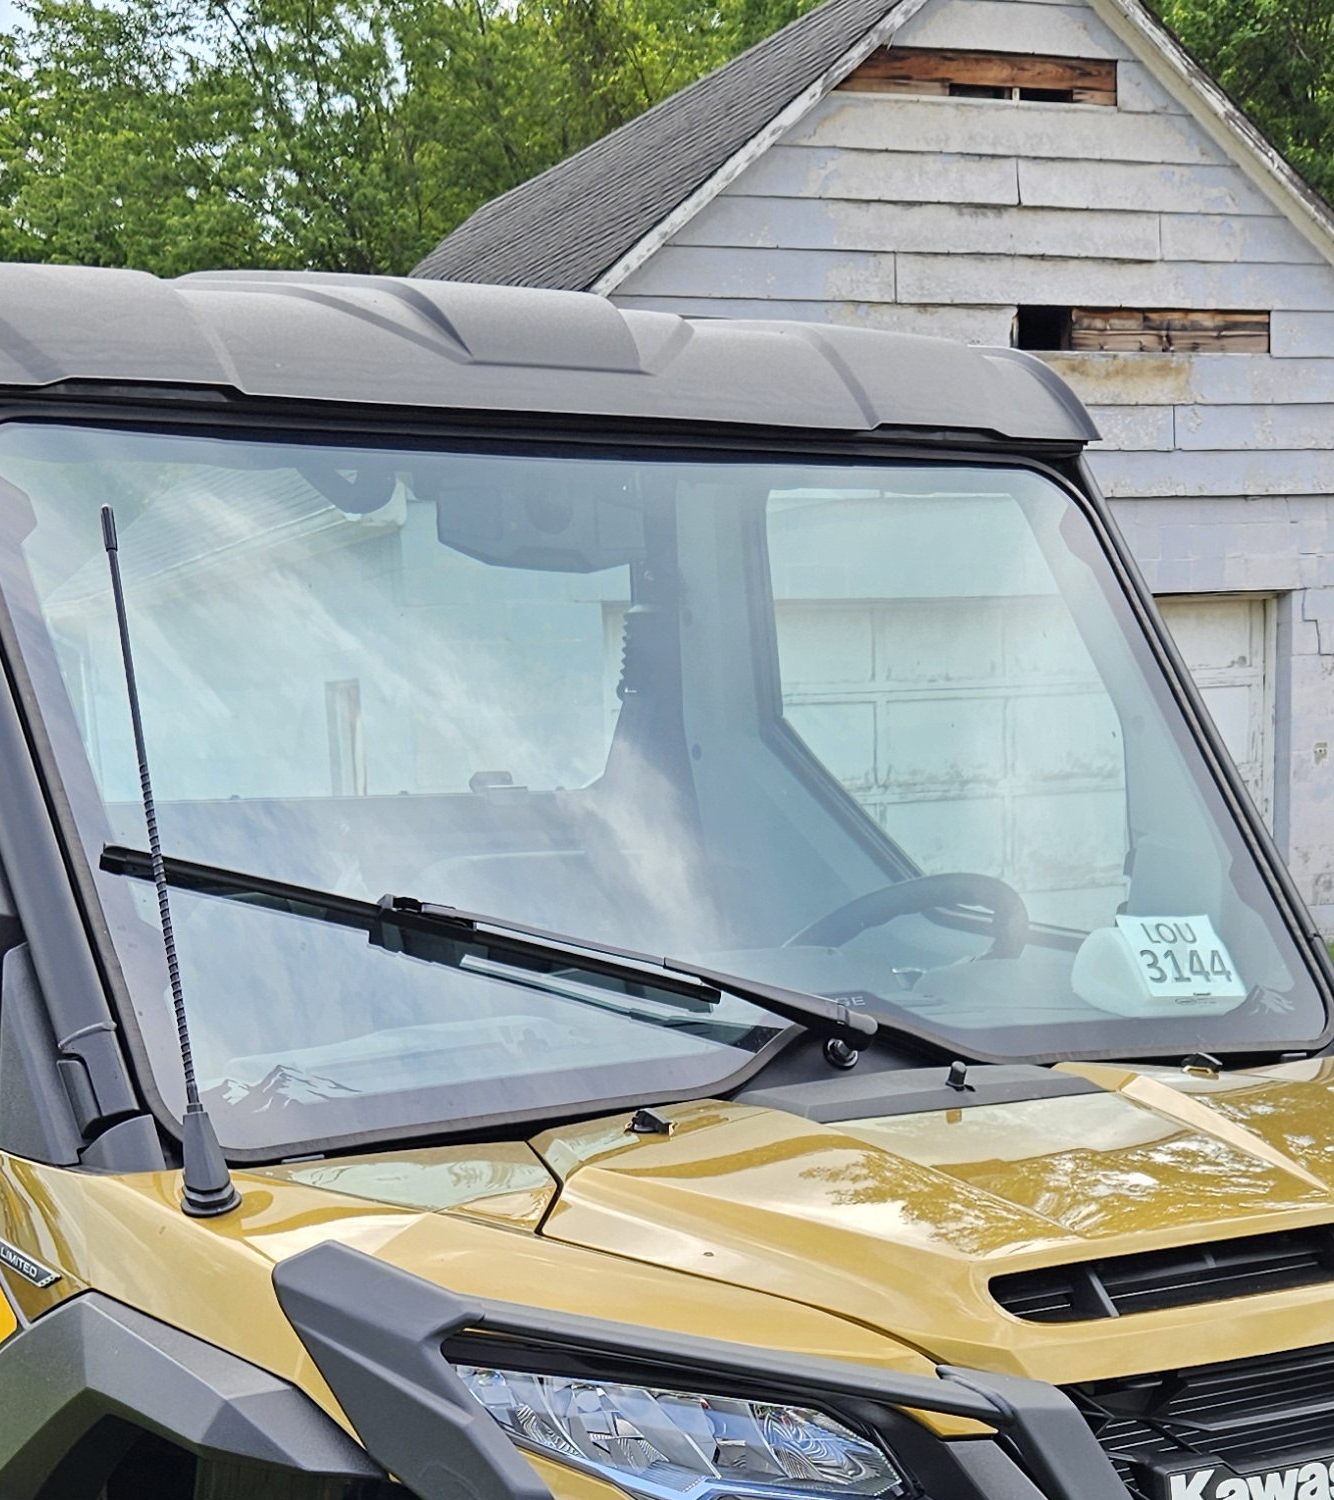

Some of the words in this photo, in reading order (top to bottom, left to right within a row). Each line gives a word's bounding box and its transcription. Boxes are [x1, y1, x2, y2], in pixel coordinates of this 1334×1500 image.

[1140, 922, 1197, 944] LOU
[1139, 949, 1233, 984] 3144
[0, 1246, 37, 1278] LIMITED
